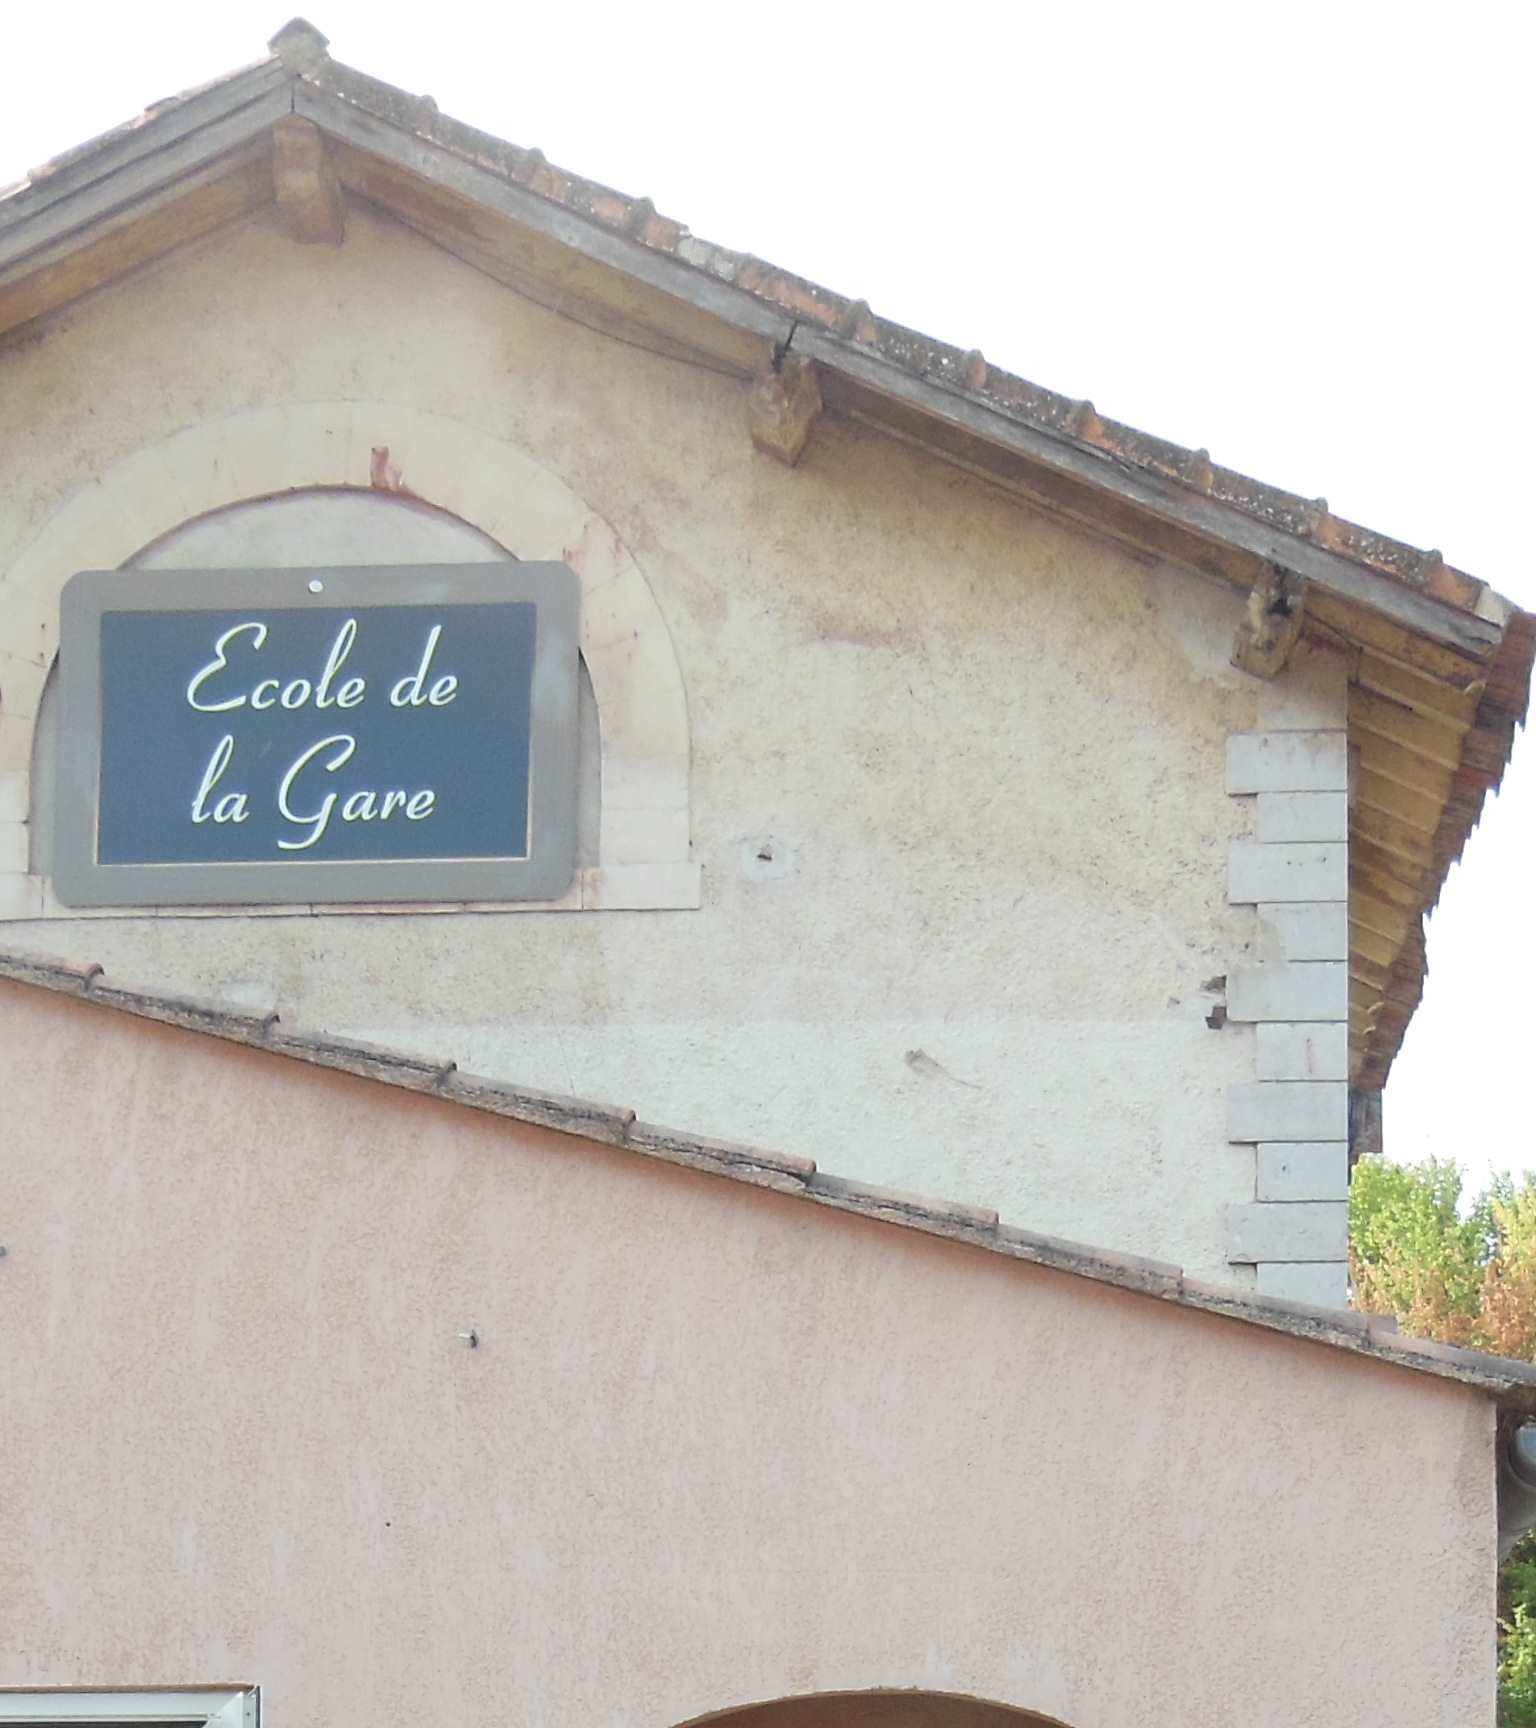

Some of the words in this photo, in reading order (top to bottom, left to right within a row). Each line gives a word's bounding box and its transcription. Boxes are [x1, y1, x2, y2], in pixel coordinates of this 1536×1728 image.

[186, 618, 366, 712] Ecole
[389, 624, 458, 707] de
[191, 734, 249, 823] la
[277, 734, 435, 849] Gare
